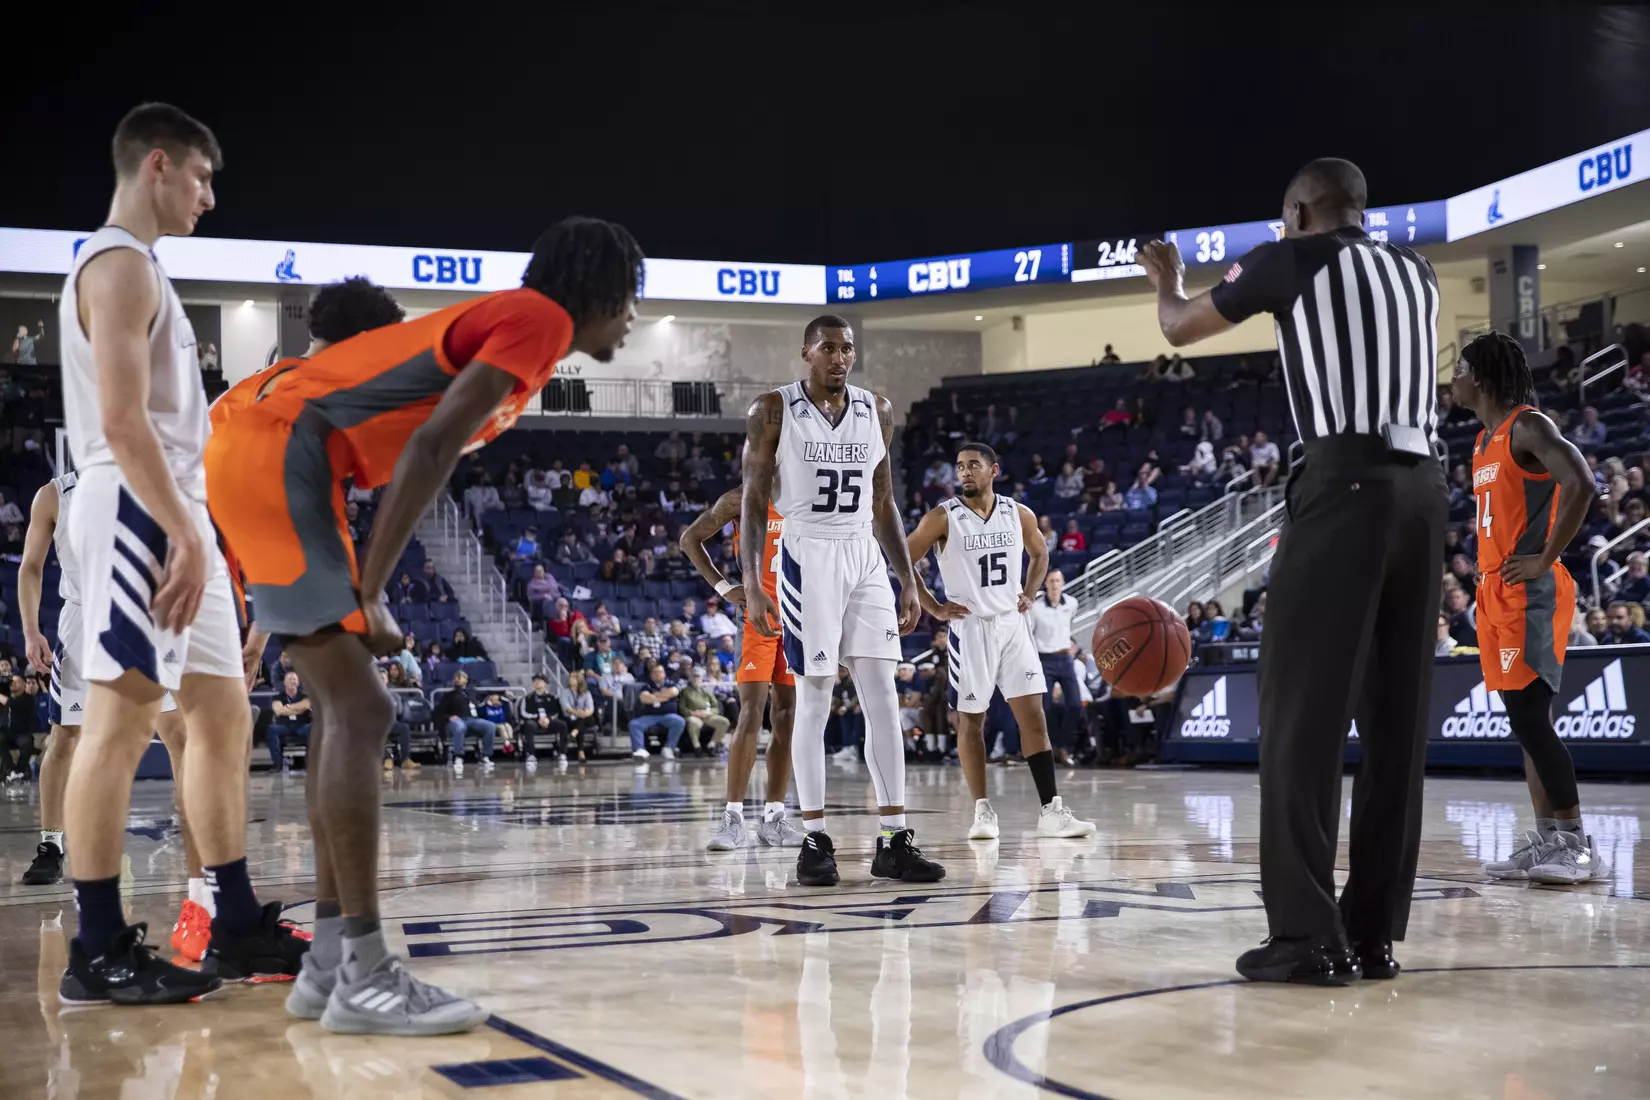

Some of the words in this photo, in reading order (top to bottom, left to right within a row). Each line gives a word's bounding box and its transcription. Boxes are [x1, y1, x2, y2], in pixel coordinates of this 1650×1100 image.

[1578, 143, 1633, 192] CBU
[1098, 238, 1138, 267] 2:46
[1195, 230, 1226, 263] 33
[412, 254, 483, 285] CBU
[837, 269, 856, 284] TOL
[908, 257, 972, 293] CBU
[1014, 249, 1042, 283] 27
[717, 268, 781, 297] CBU
[554, 364, 582, 375] ALLY
[804, 441, 869, 464] LANCERS
[811, 468, 864, 514] 35
[963, 530, 1016, 552] LANCERS
[977, 551, 1008, 588] 15
[1181, 714, 1231, 738] adidas
[1441, 710, 1512, 738] adidas
[1554, 709, 1636, 739] adidas
